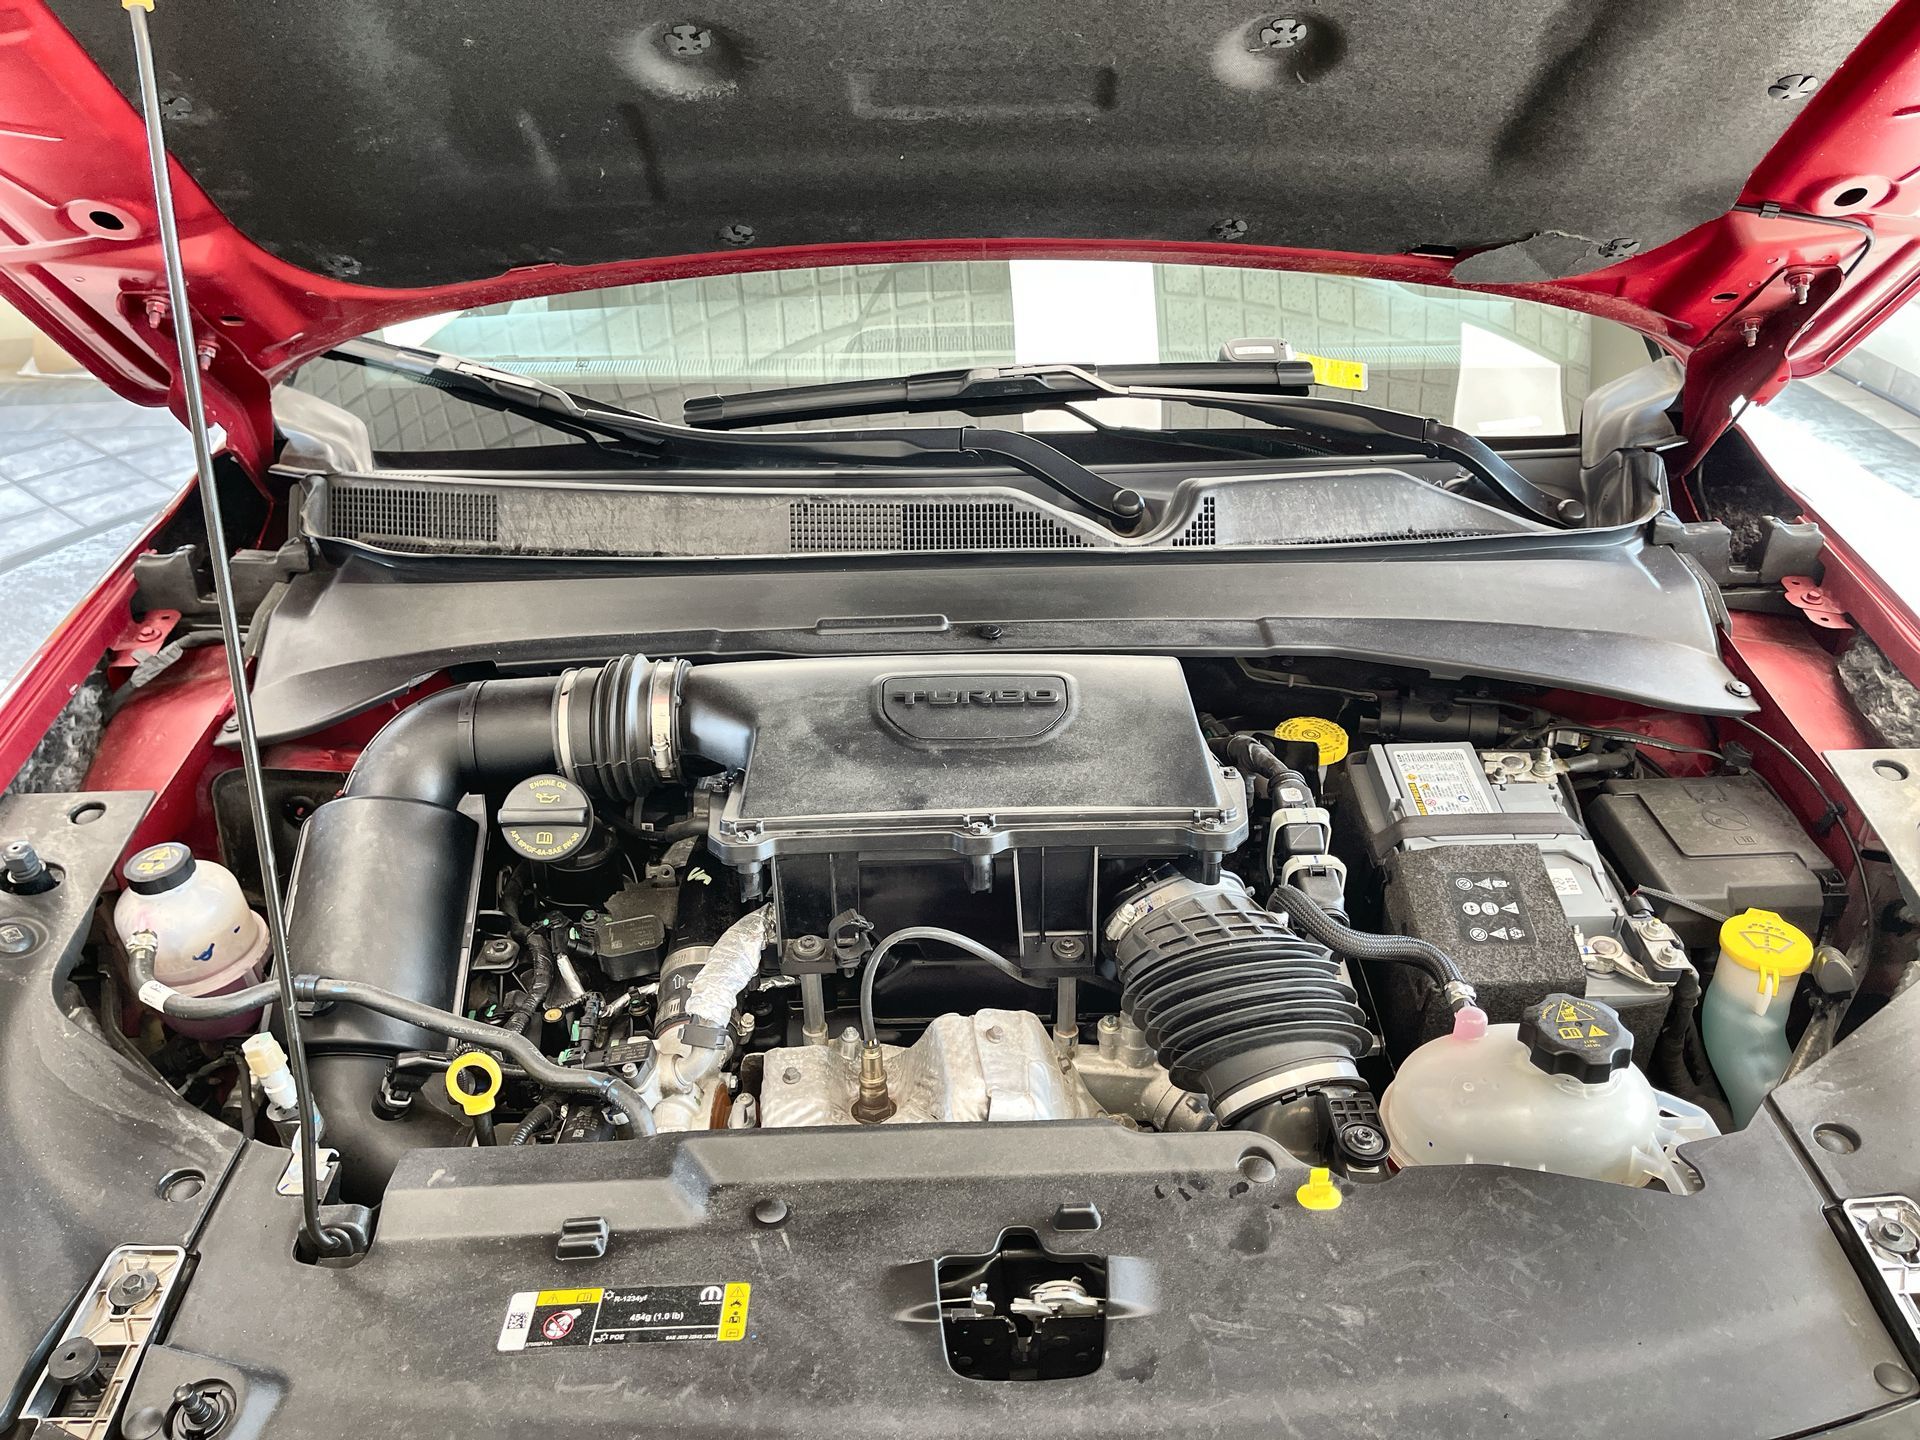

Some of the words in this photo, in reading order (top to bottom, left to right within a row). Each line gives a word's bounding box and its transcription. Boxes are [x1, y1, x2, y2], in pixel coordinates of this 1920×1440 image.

[893, 689, 1059, 706] TURBO
[529, 780, 555, 790] ENGINE
[557, 781, 567, 791] OIL
[510, 830, 519, 842] API
[563, 832, 580, 849] 5W-30
[614, 1294, 648, 1303] R-1234yf
[630, 1312, 652, 1322] 454g
[653, 1312, 669, 1321] (1.0
[672, 1312, 684, 1320] lb)
